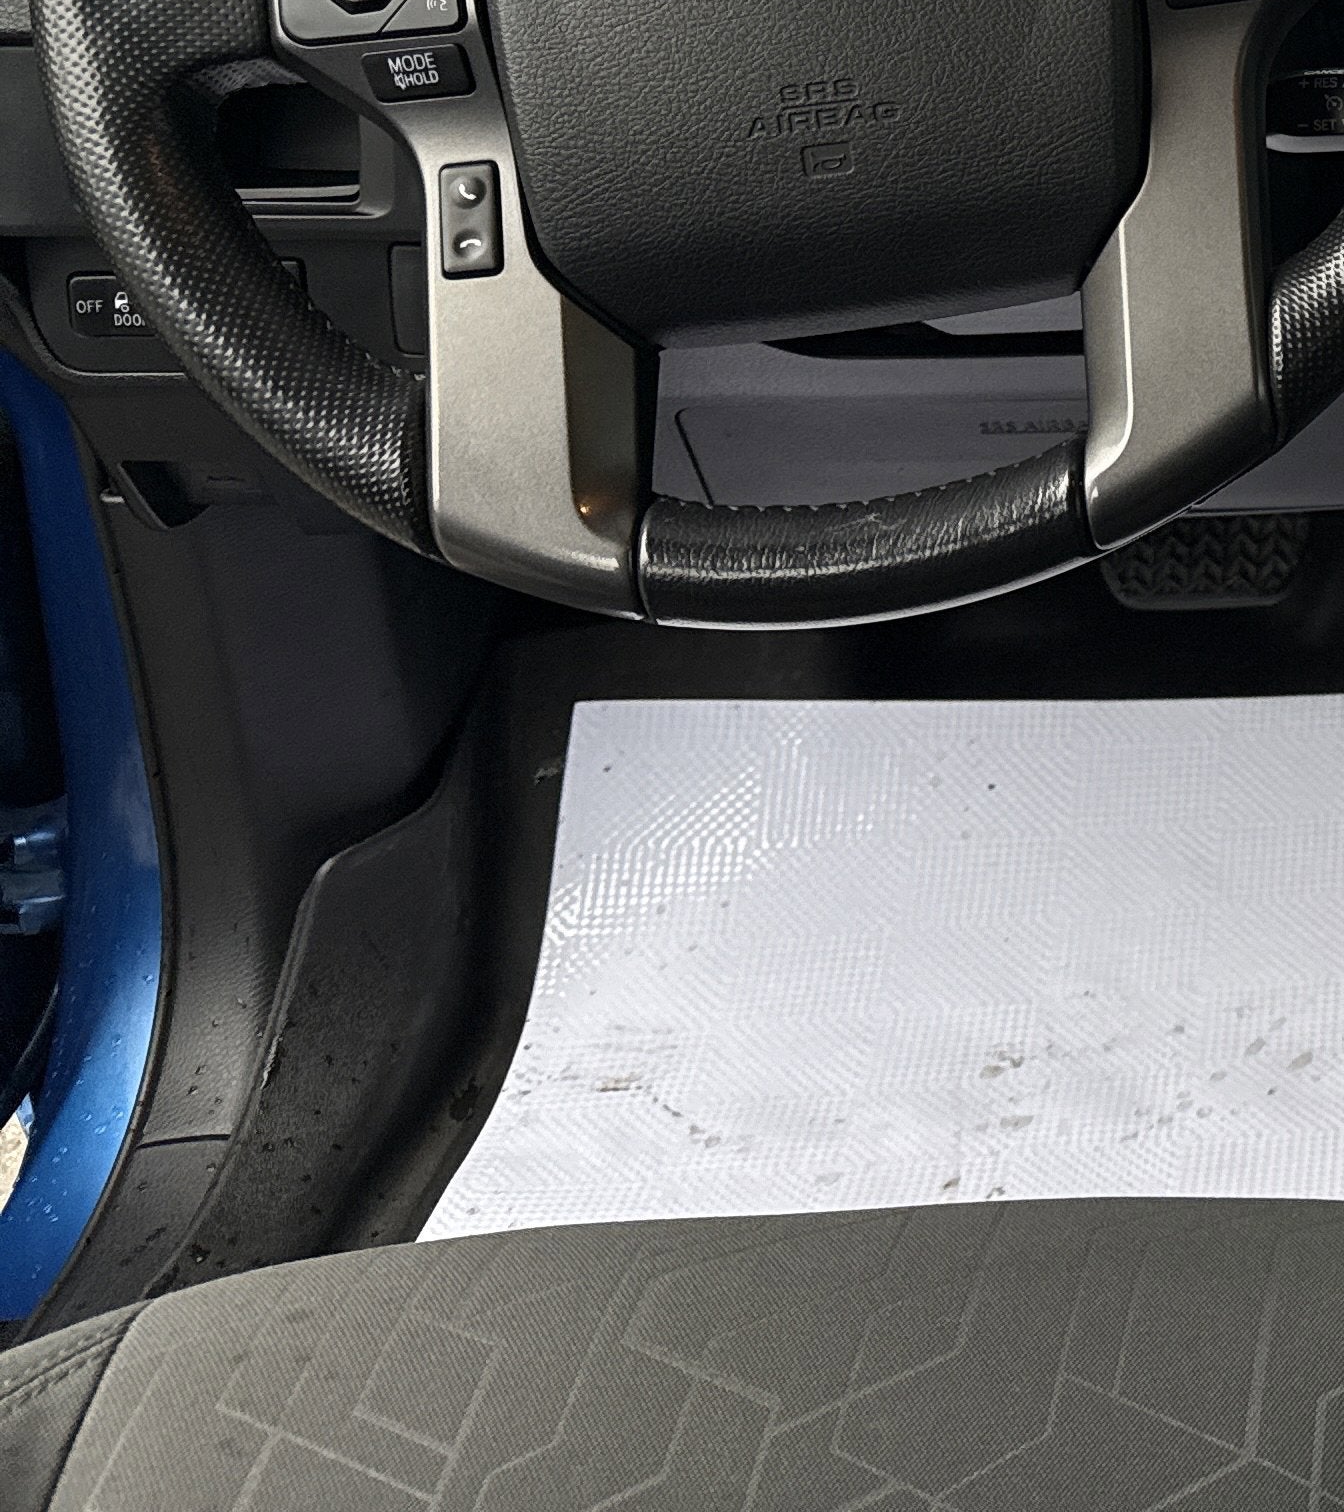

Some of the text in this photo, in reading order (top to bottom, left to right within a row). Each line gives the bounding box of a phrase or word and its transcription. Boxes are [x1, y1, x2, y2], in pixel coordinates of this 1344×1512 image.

[387, 52, 438, 74] MODE
[405, 70, 440, 88] HOLD
[1313, 76, 1338, 88] RES
[779, 78, 860, 103] SRS
[748, 101, 902, 139] AIRBAG
[1312, 119, 1337, 131] SET
[76, 300, 104, 314] OFF
